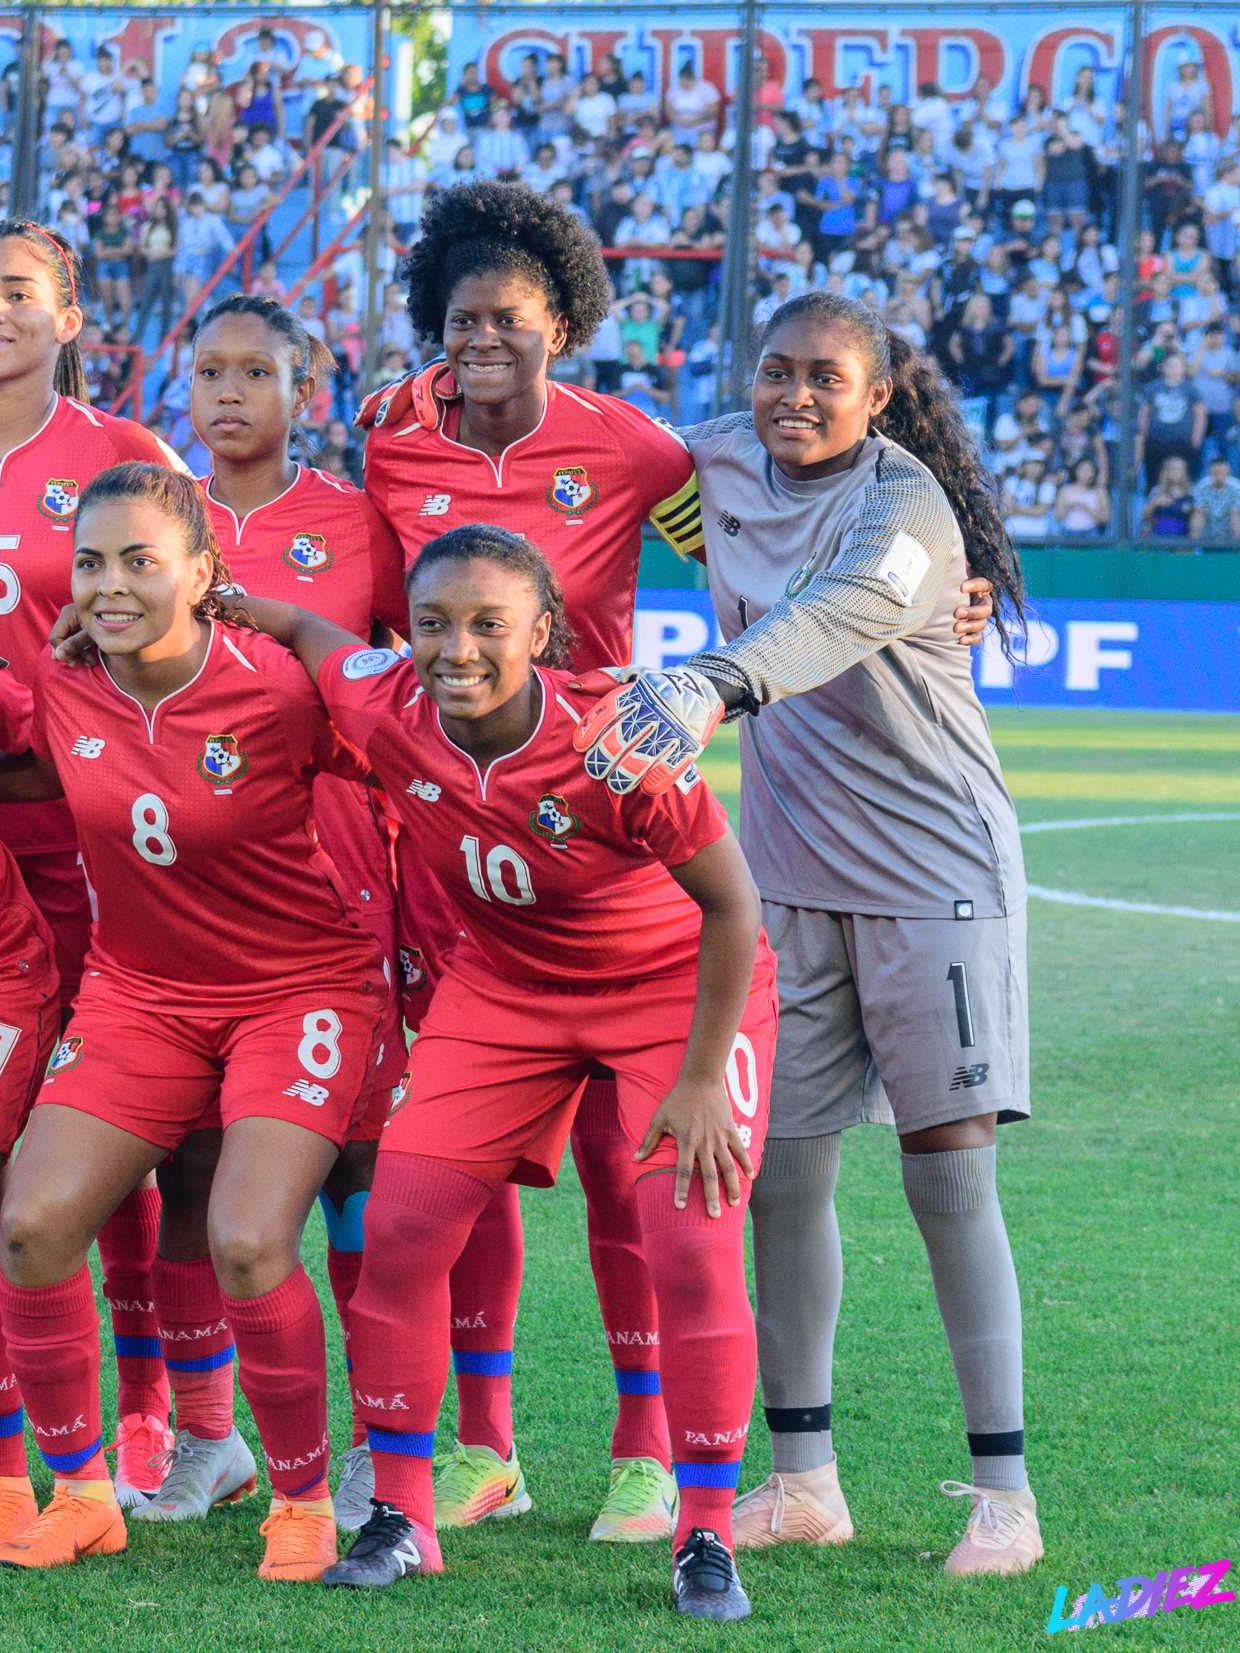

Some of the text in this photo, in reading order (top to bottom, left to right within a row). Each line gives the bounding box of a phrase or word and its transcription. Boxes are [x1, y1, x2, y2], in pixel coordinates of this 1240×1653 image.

[131, 793, 178, 866] 8
[459, 835, 537, 906] 10
[946, 961, 976, 1048] 1
[297, 1008, 343, 1079] 8
[723, 1032, 759, 1119] 0
